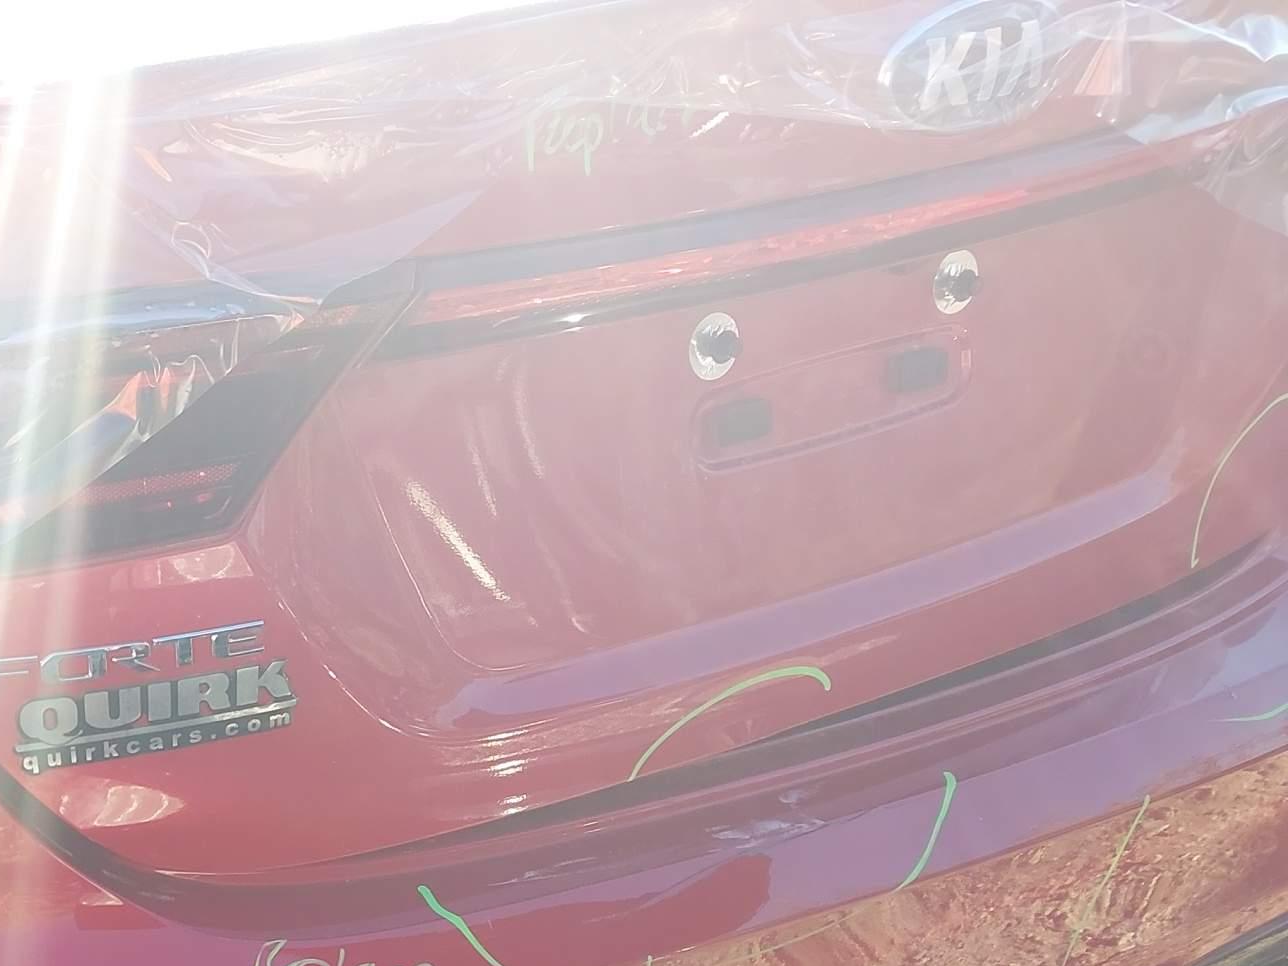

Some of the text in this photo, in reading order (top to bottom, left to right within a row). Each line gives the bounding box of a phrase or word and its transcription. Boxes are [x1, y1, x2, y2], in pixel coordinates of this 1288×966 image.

[918, 19, 1043, 112] KIA
[17, 660, 294, 746] QUIRK
[21, 709, 293, 775] quirkcars.com
